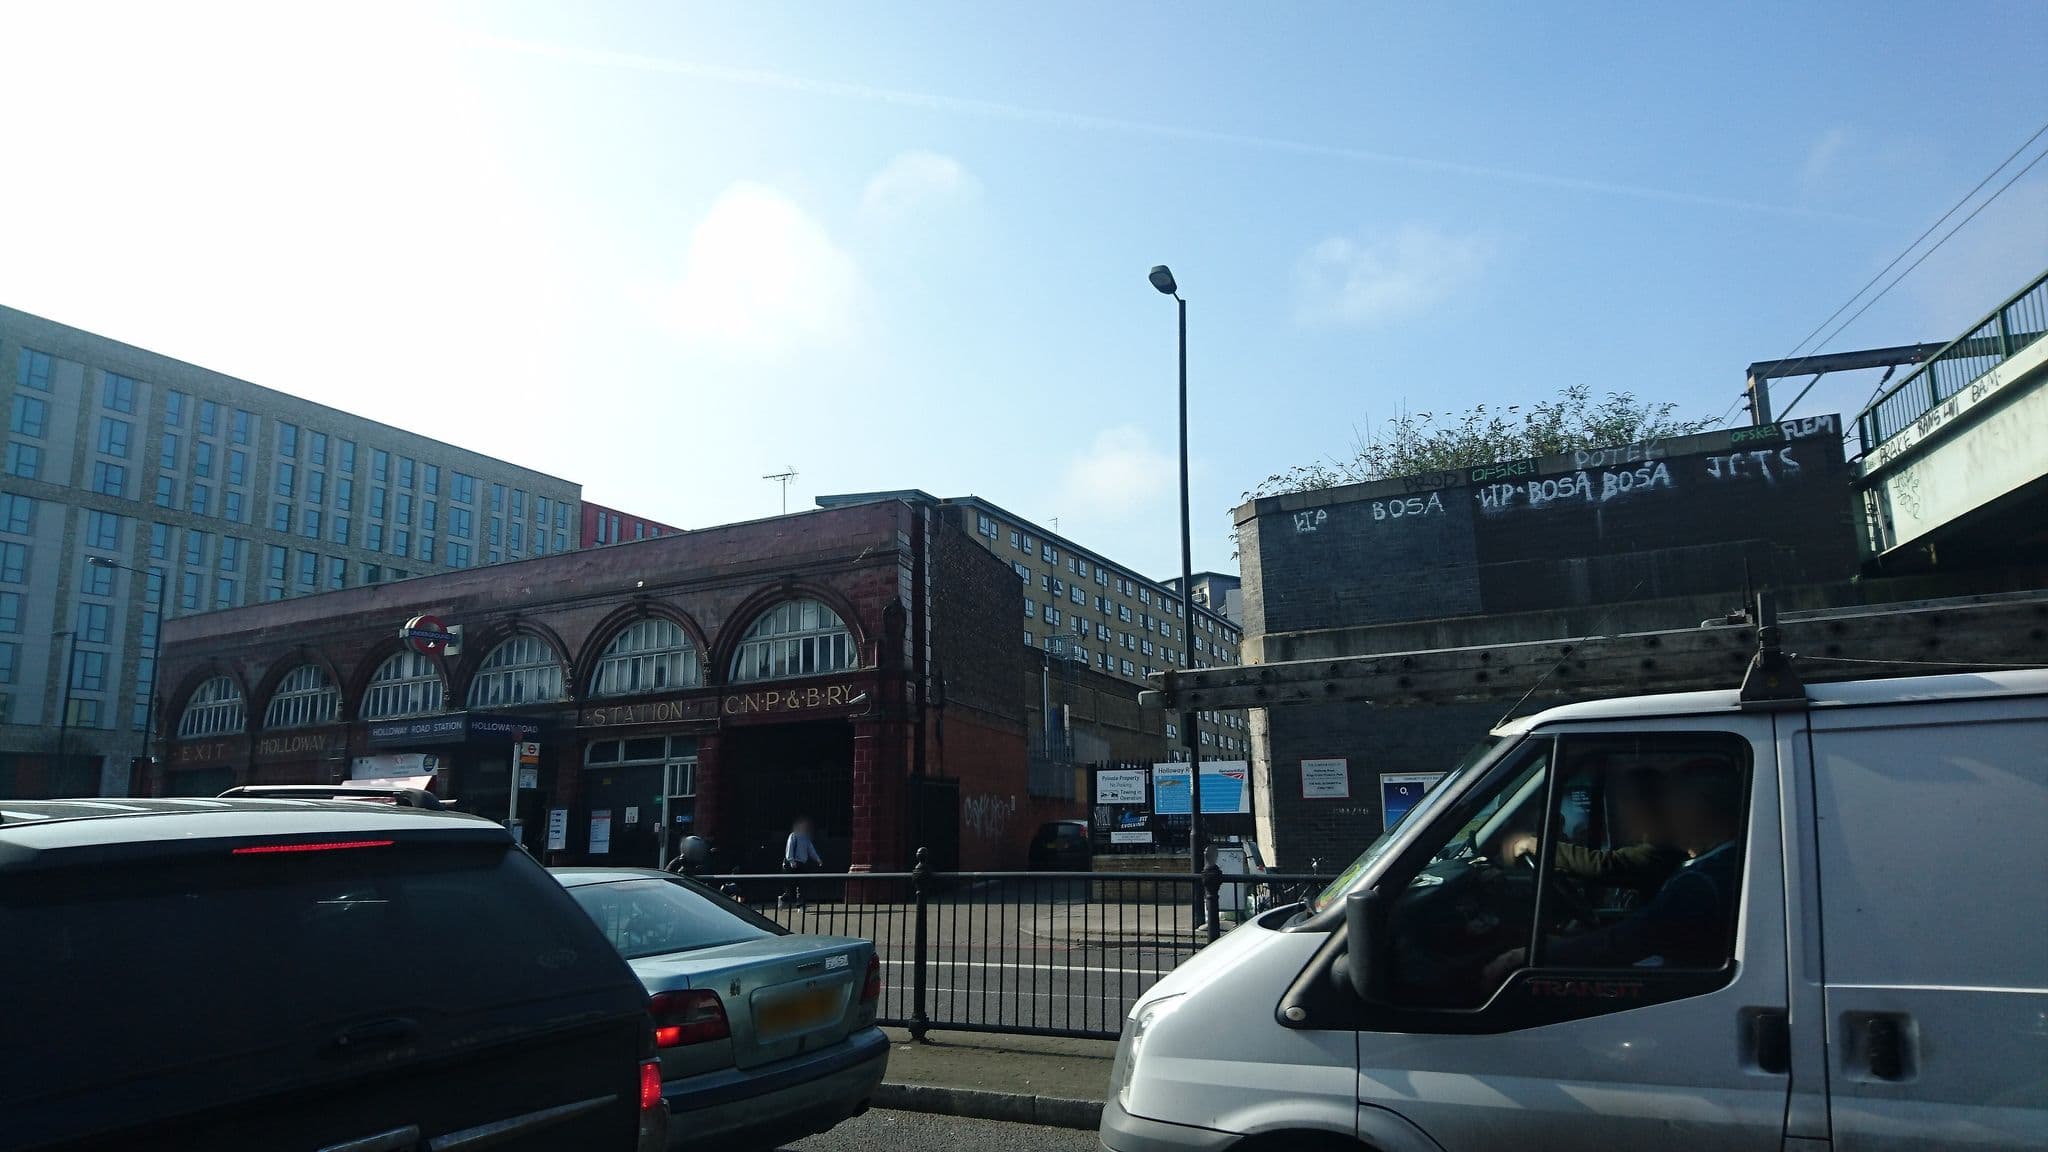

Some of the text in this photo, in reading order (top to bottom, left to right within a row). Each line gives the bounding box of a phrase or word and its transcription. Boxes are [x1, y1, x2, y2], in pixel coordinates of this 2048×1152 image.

[1528, 470, 1593, 508] BOSA
[1601, 461, 1672, 502] BOSA
[1372, 492, 1446, 521] BOSA
[372, 721, 463, 737] HOLLOWAY ROAD STATION
[182, 743, 225, 761] EXIT
[260, 735, 327, 754] HOLLOWAY
